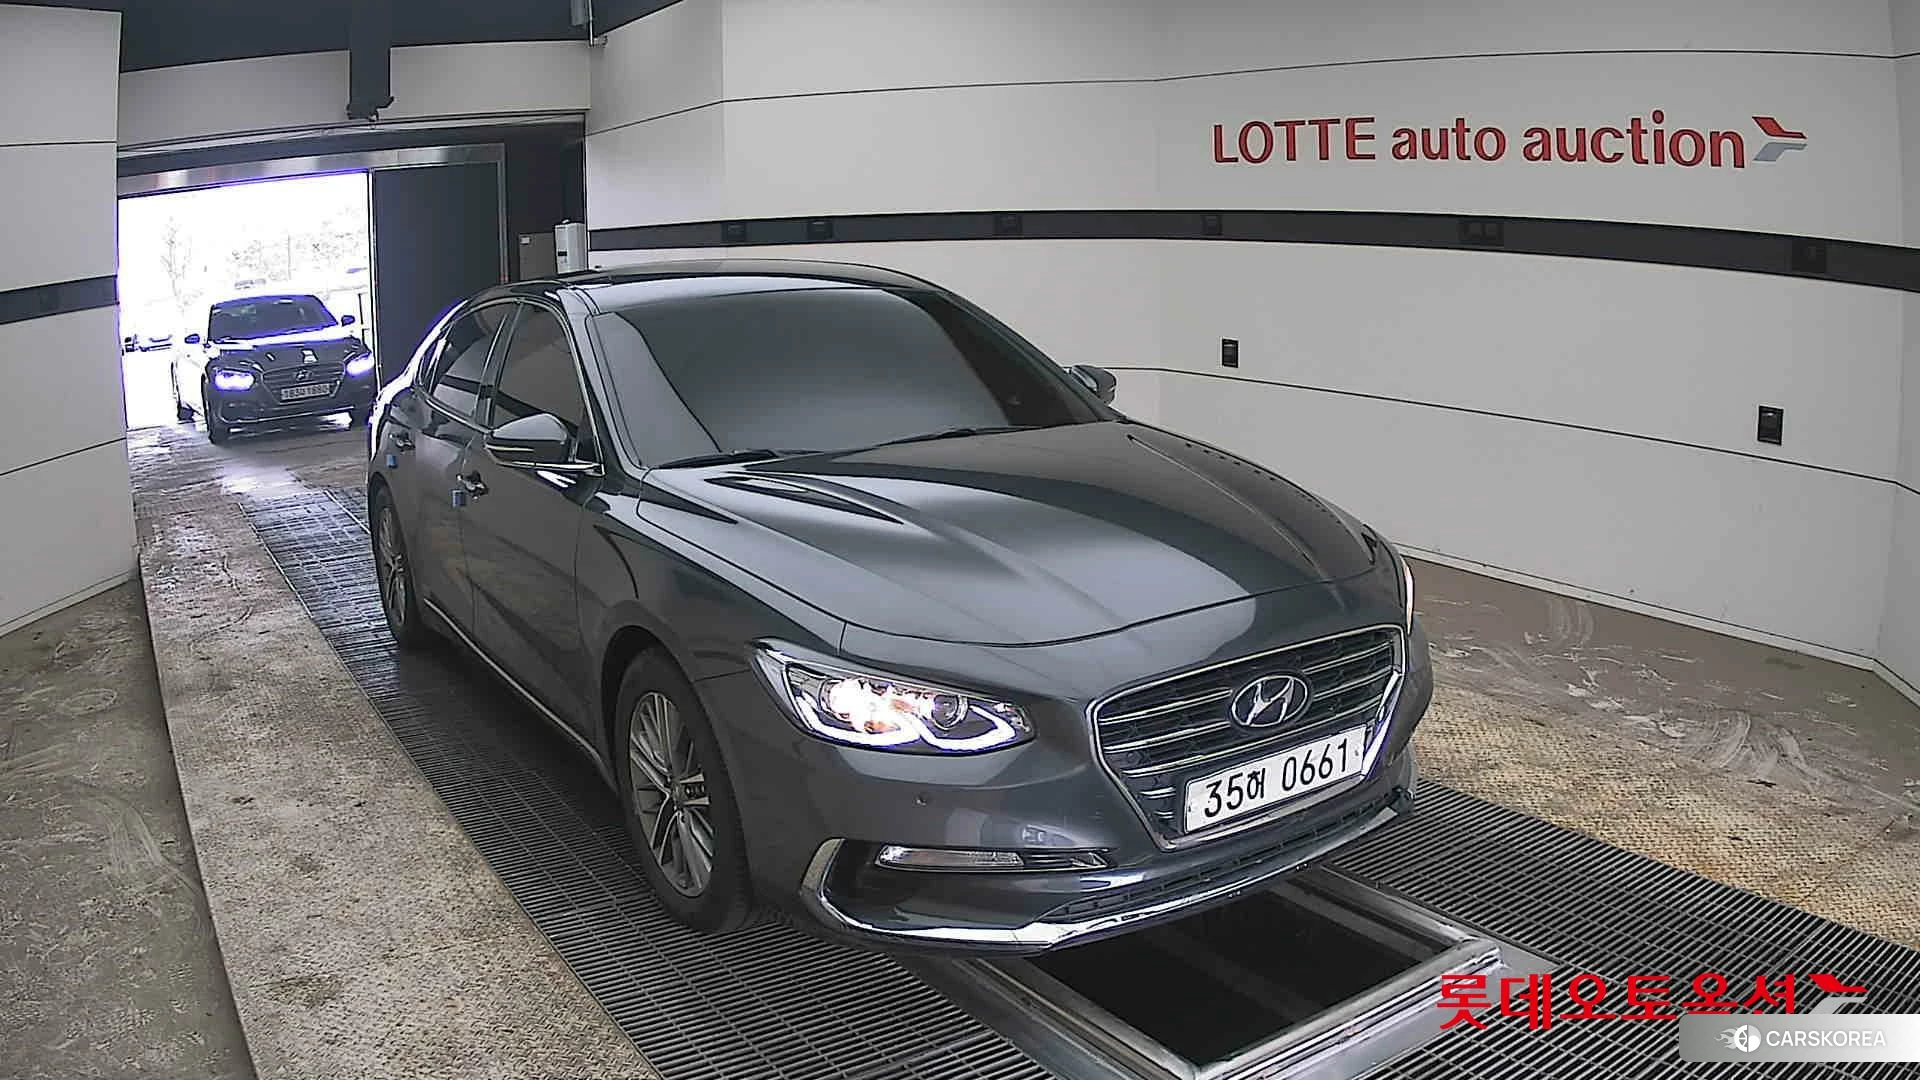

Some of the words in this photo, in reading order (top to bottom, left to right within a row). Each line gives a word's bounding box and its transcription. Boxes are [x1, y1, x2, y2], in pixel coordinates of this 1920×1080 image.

[1213, 117, 1376, 164] LOTTE
[1391, 117, 1507, 162] auto
[1522, 110, 1745, 168] auction
[1281, 738, 1348, 792] 0661
